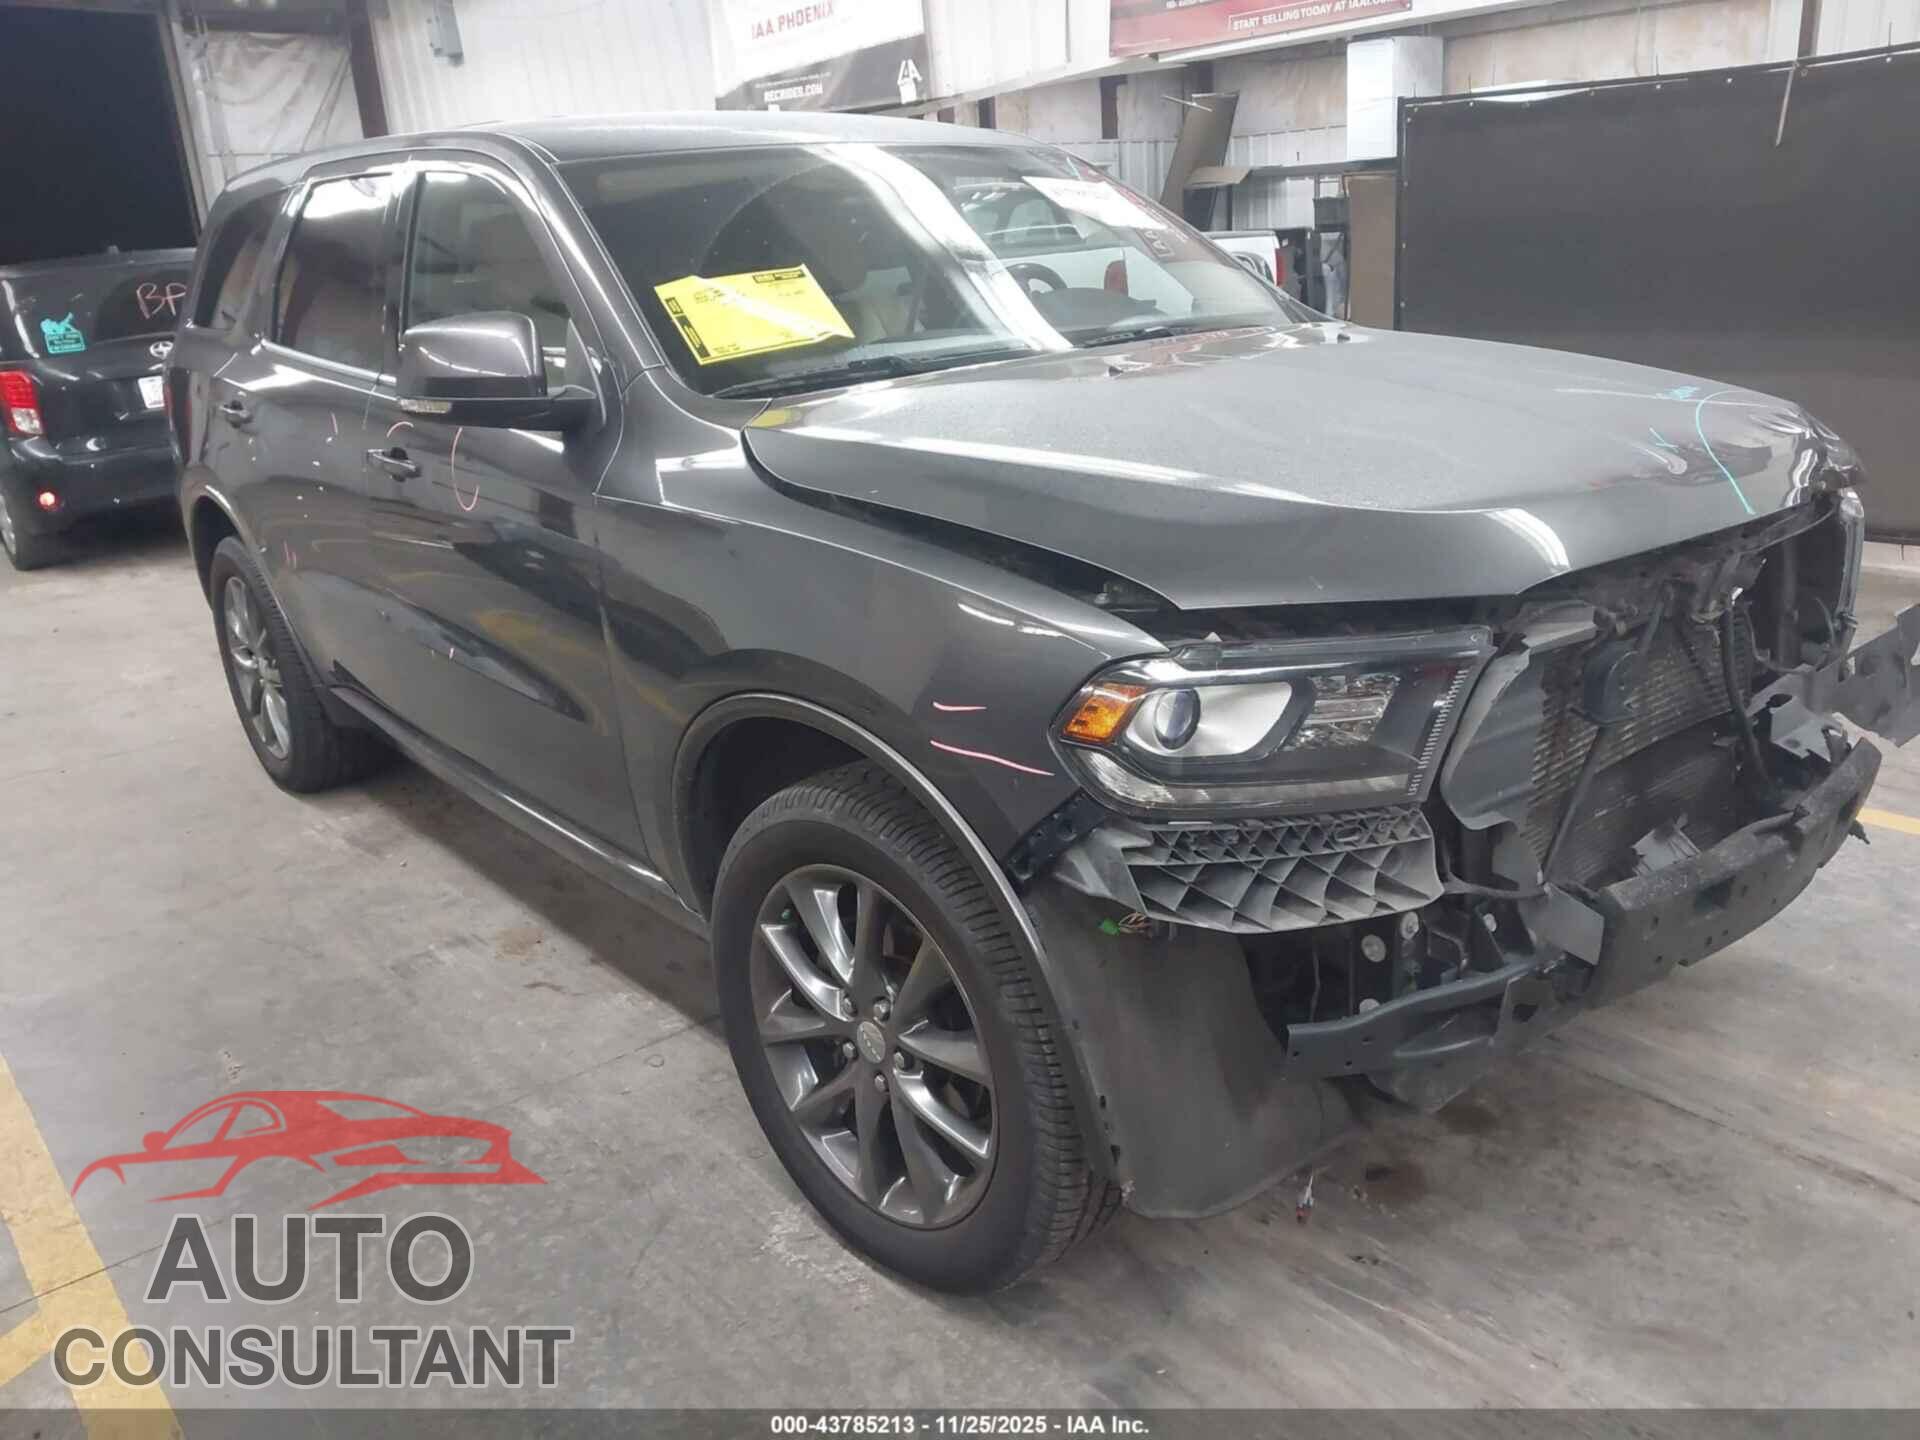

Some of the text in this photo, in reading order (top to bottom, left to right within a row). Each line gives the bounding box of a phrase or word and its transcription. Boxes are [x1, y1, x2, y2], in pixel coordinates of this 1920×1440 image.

[778, 0, 835, 33] PHOENIX
[1262, 10, 1301, 25] SELLING
[1300, 3, 1334, 18] TODAY
[1333, 1, 1345, 13] AT
